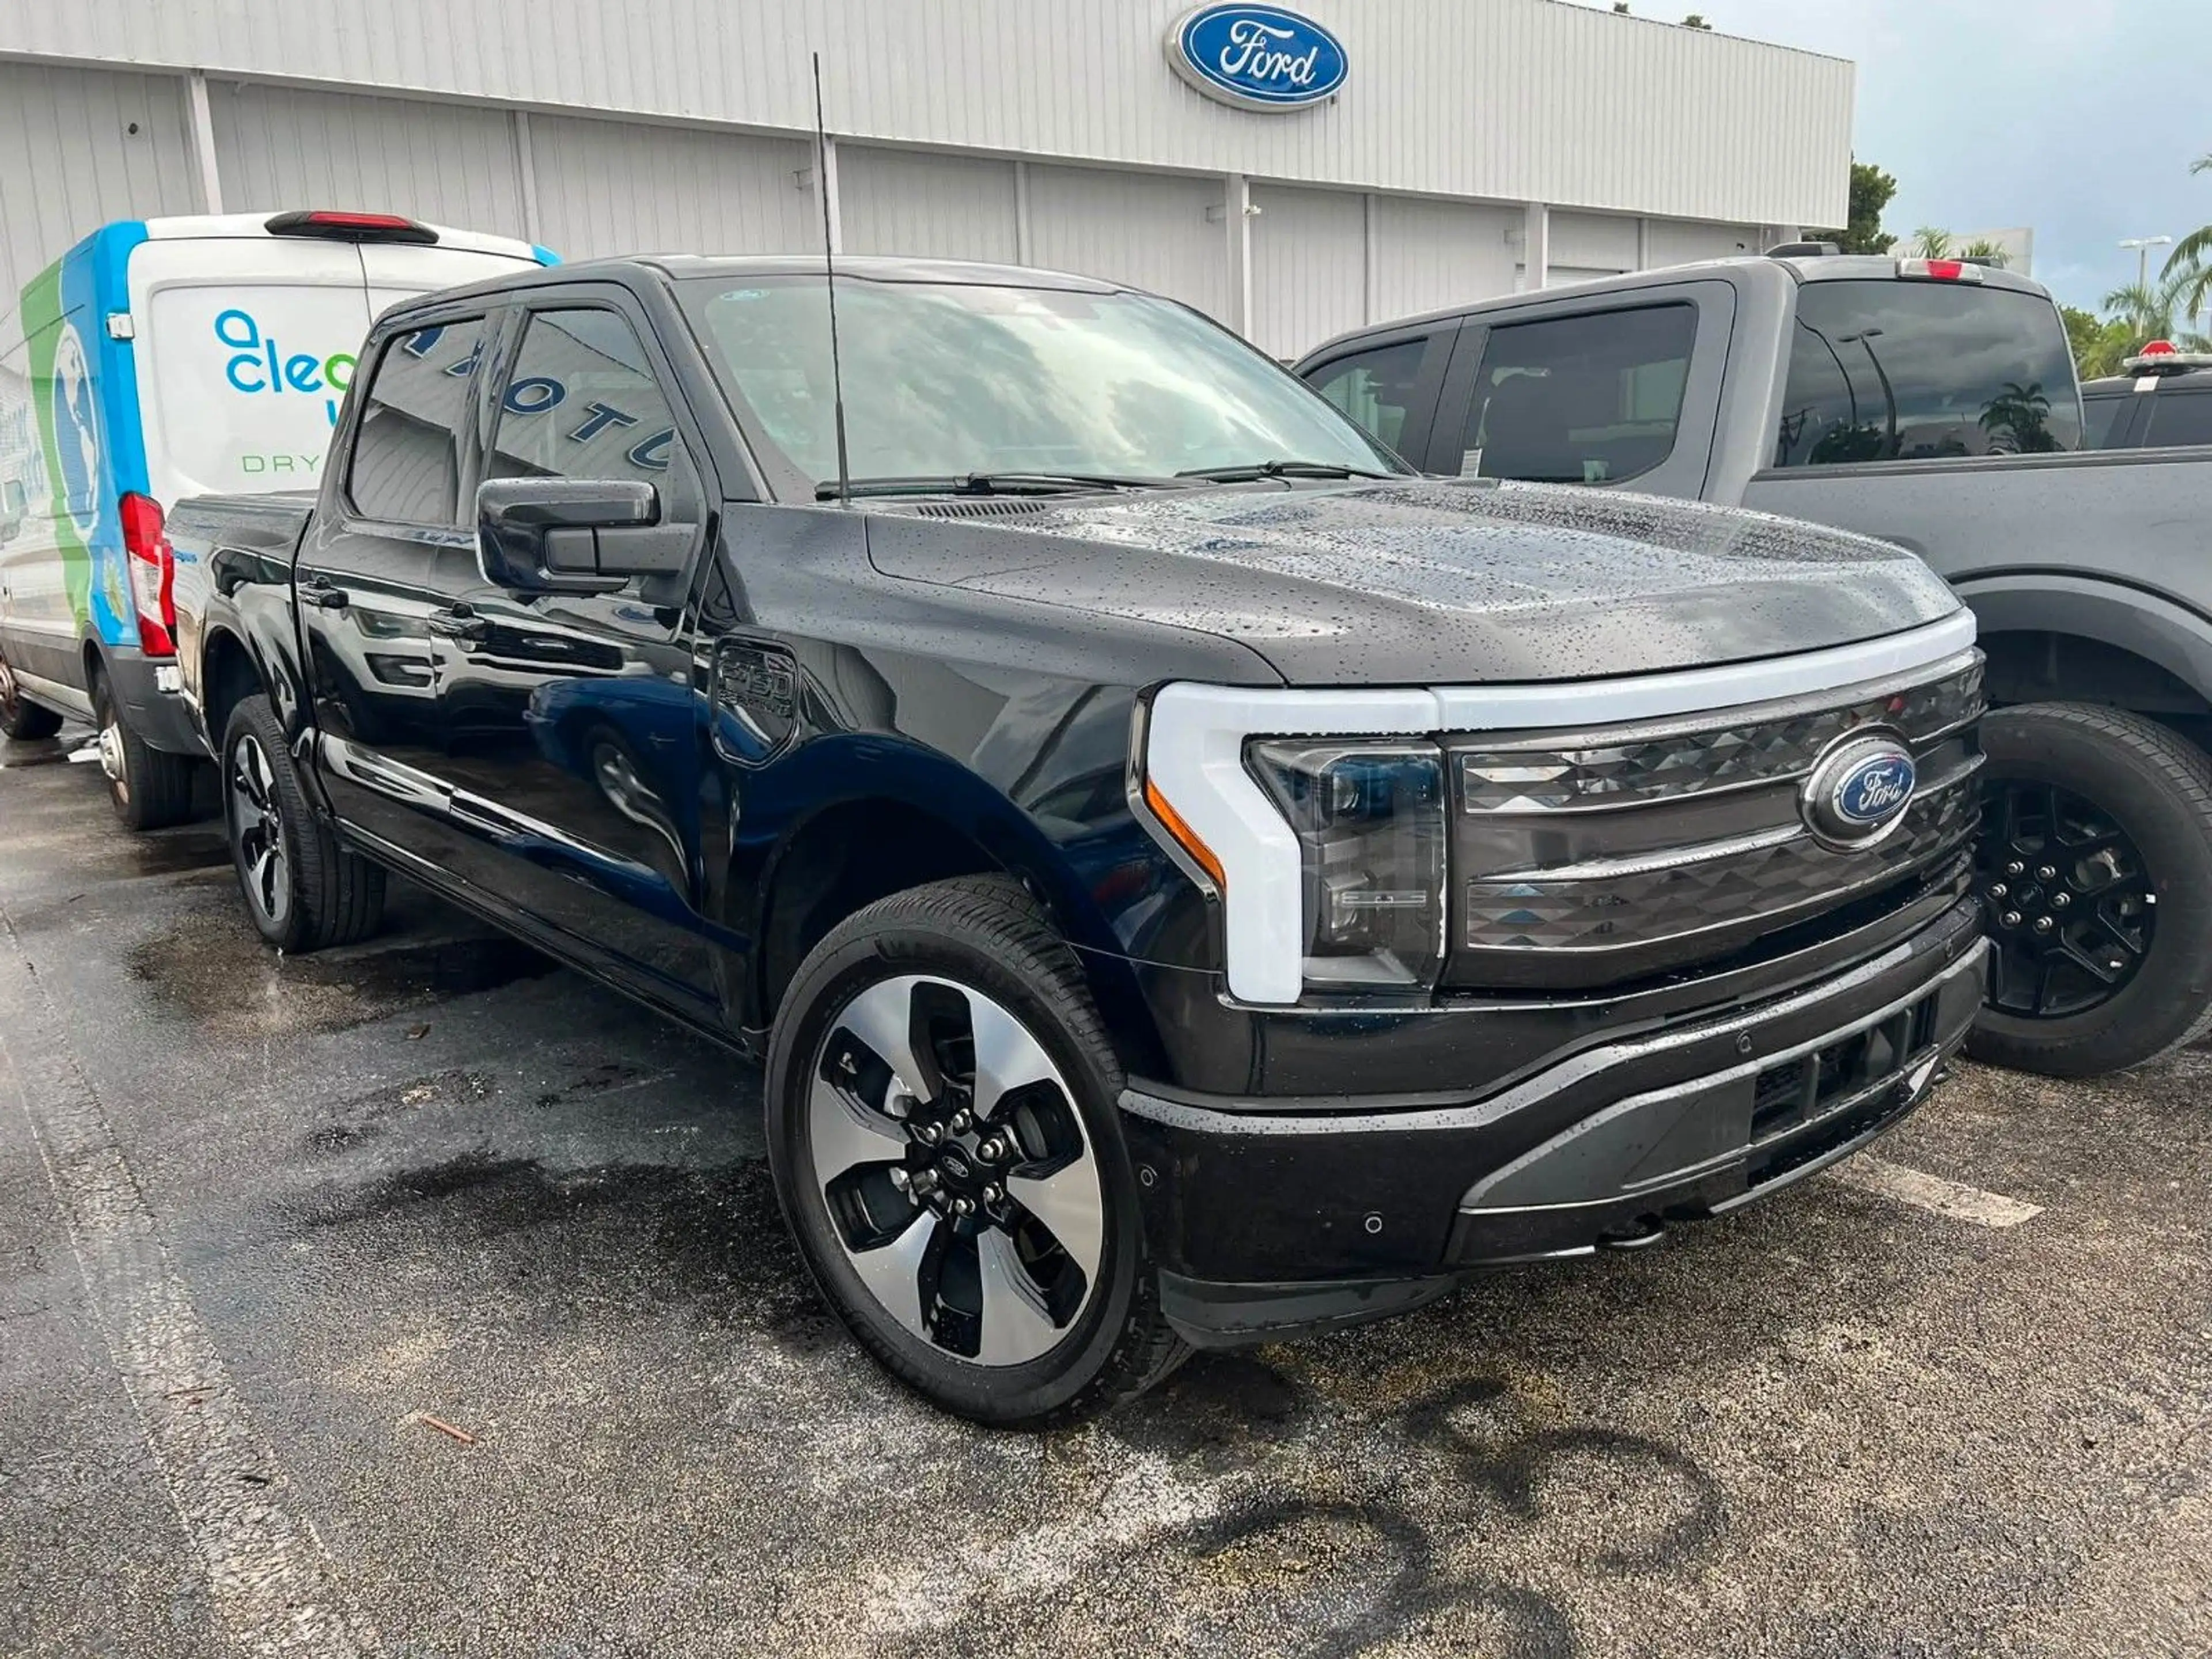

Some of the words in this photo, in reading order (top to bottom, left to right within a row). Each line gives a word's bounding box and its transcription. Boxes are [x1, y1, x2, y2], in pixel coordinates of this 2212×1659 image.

[1219, 20, 1318, 84] Ford
[242, 455, 320, 472] DRY
[1859, 767, 1903, 811] Ford
